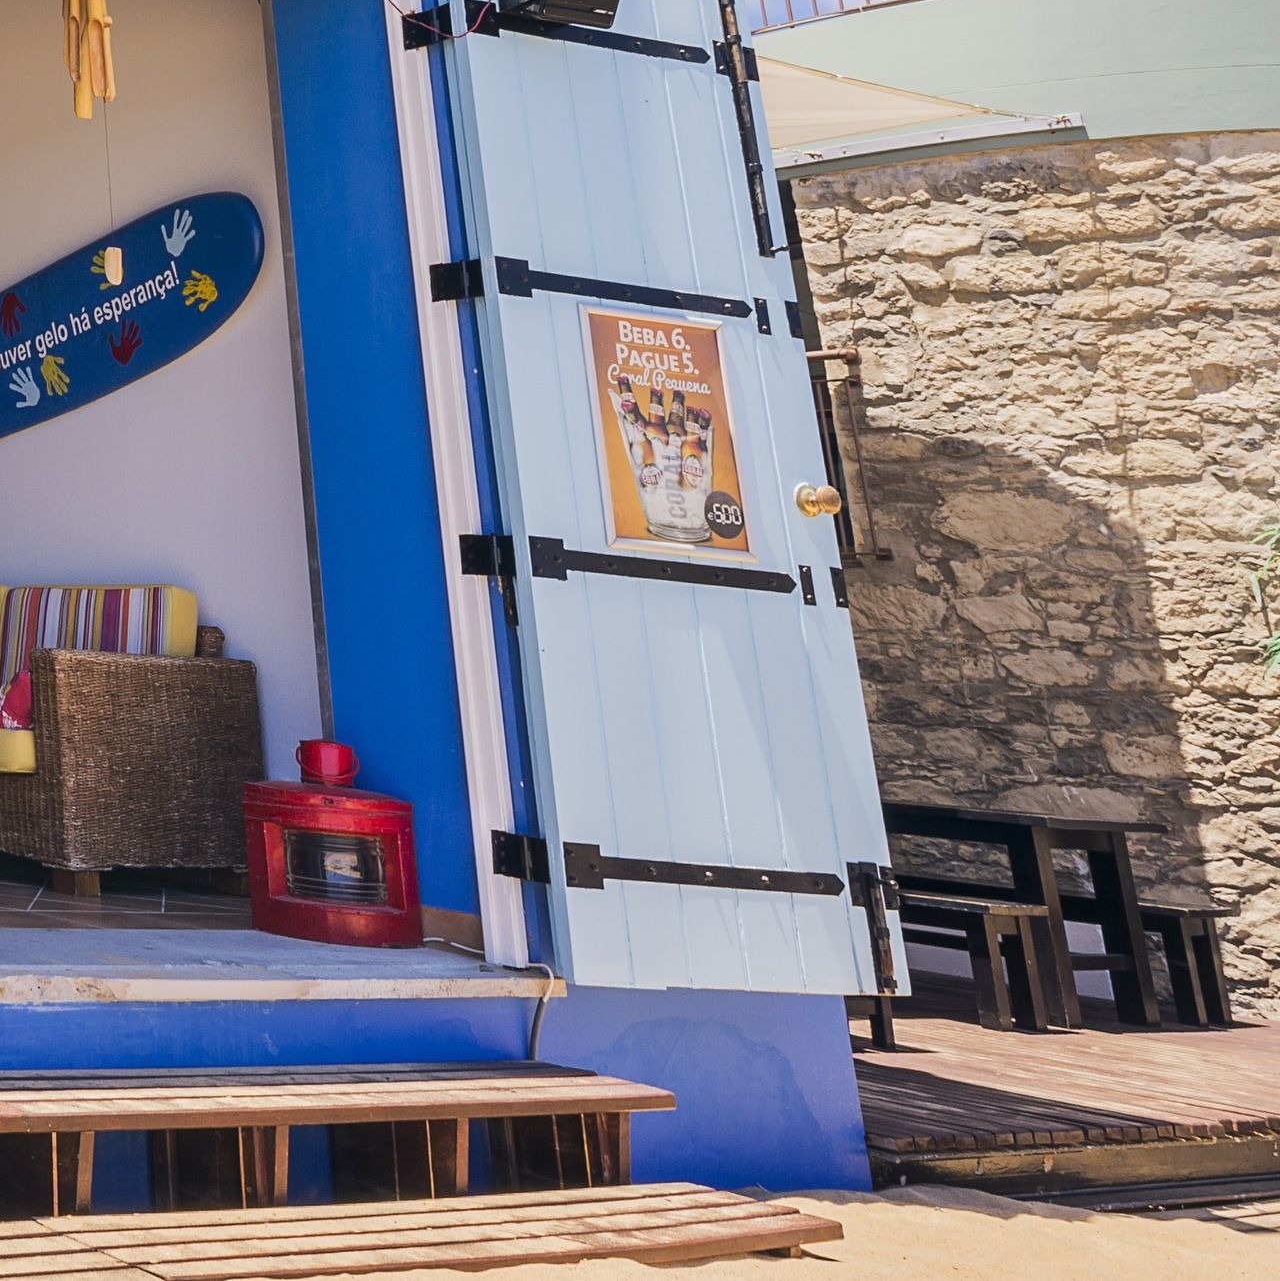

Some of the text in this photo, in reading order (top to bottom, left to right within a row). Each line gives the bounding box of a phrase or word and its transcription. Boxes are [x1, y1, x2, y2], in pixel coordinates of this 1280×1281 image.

[35, 321, 68, 358] gelo
[69, 306, 92, 337] há
[93, 260, 180, 323] esperança!
[618, 320, 691, 351] BEBA 6.
[615, 343, 700, 375] PAGUE 5.
